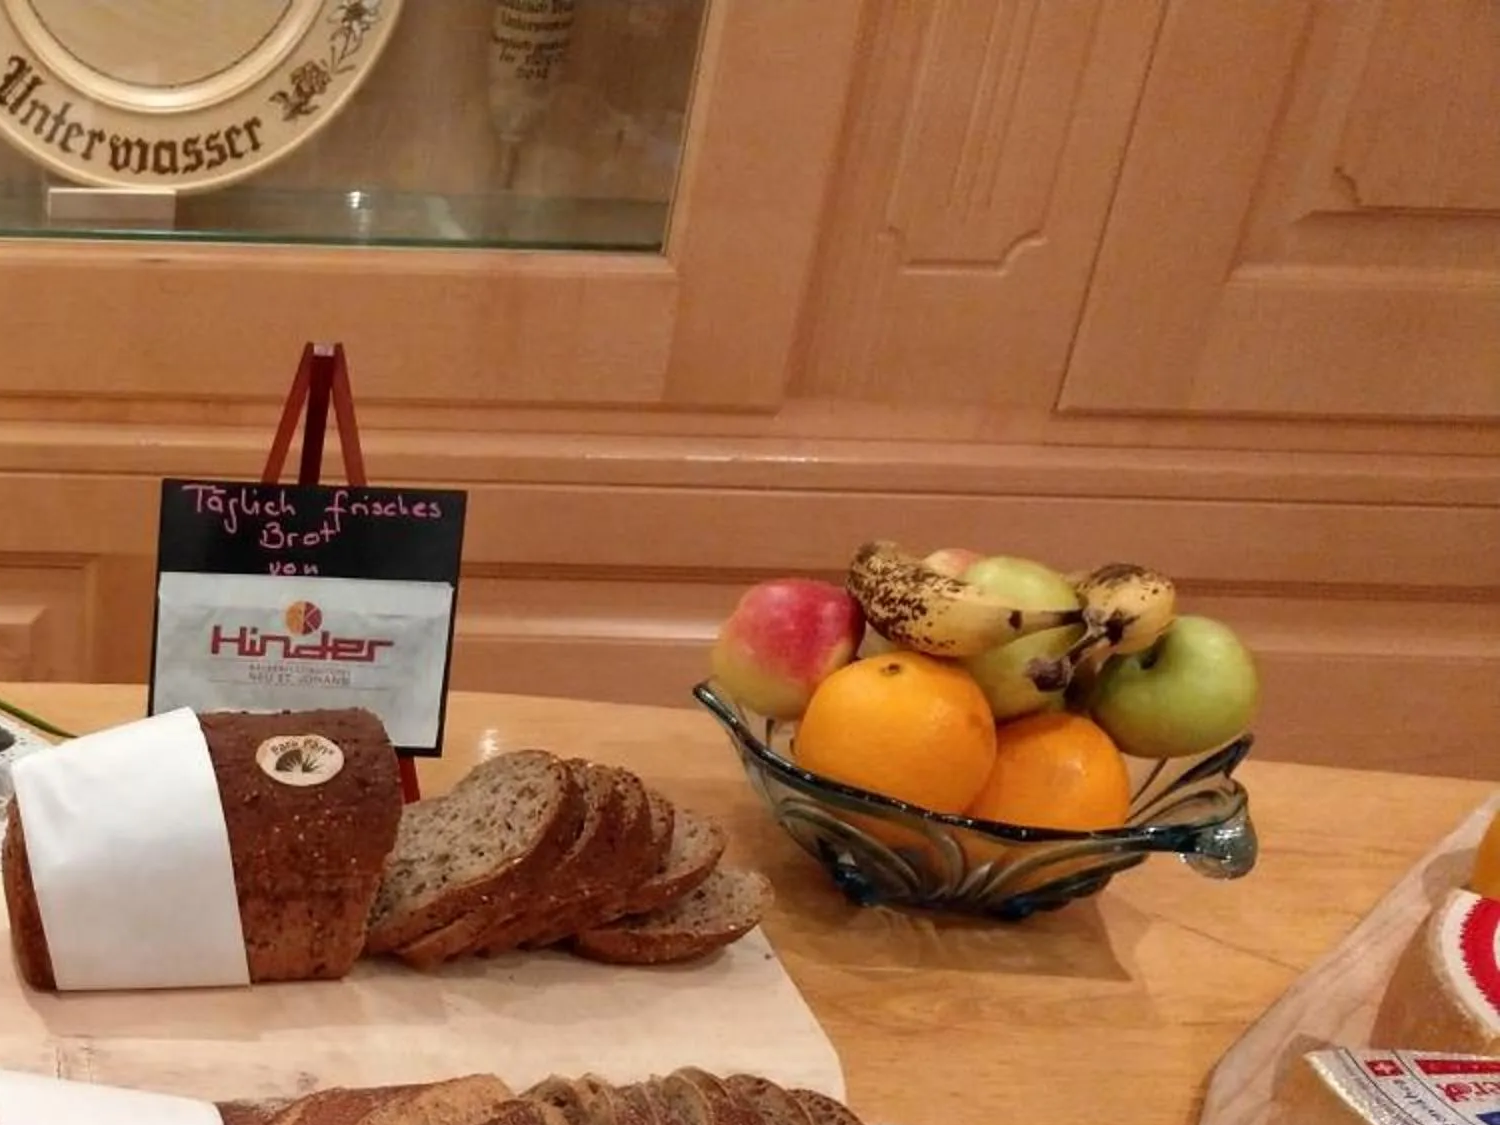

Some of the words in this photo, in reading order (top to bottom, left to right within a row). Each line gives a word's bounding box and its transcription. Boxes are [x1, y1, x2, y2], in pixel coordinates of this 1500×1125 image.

[182, 483, 298, 534] Täglich
[325, 489, 443, 533] frisches
[259, 522, 335, 550] Brot
[268, 561, 319, 577] von
[210, 624, 395, 664] Hinder
